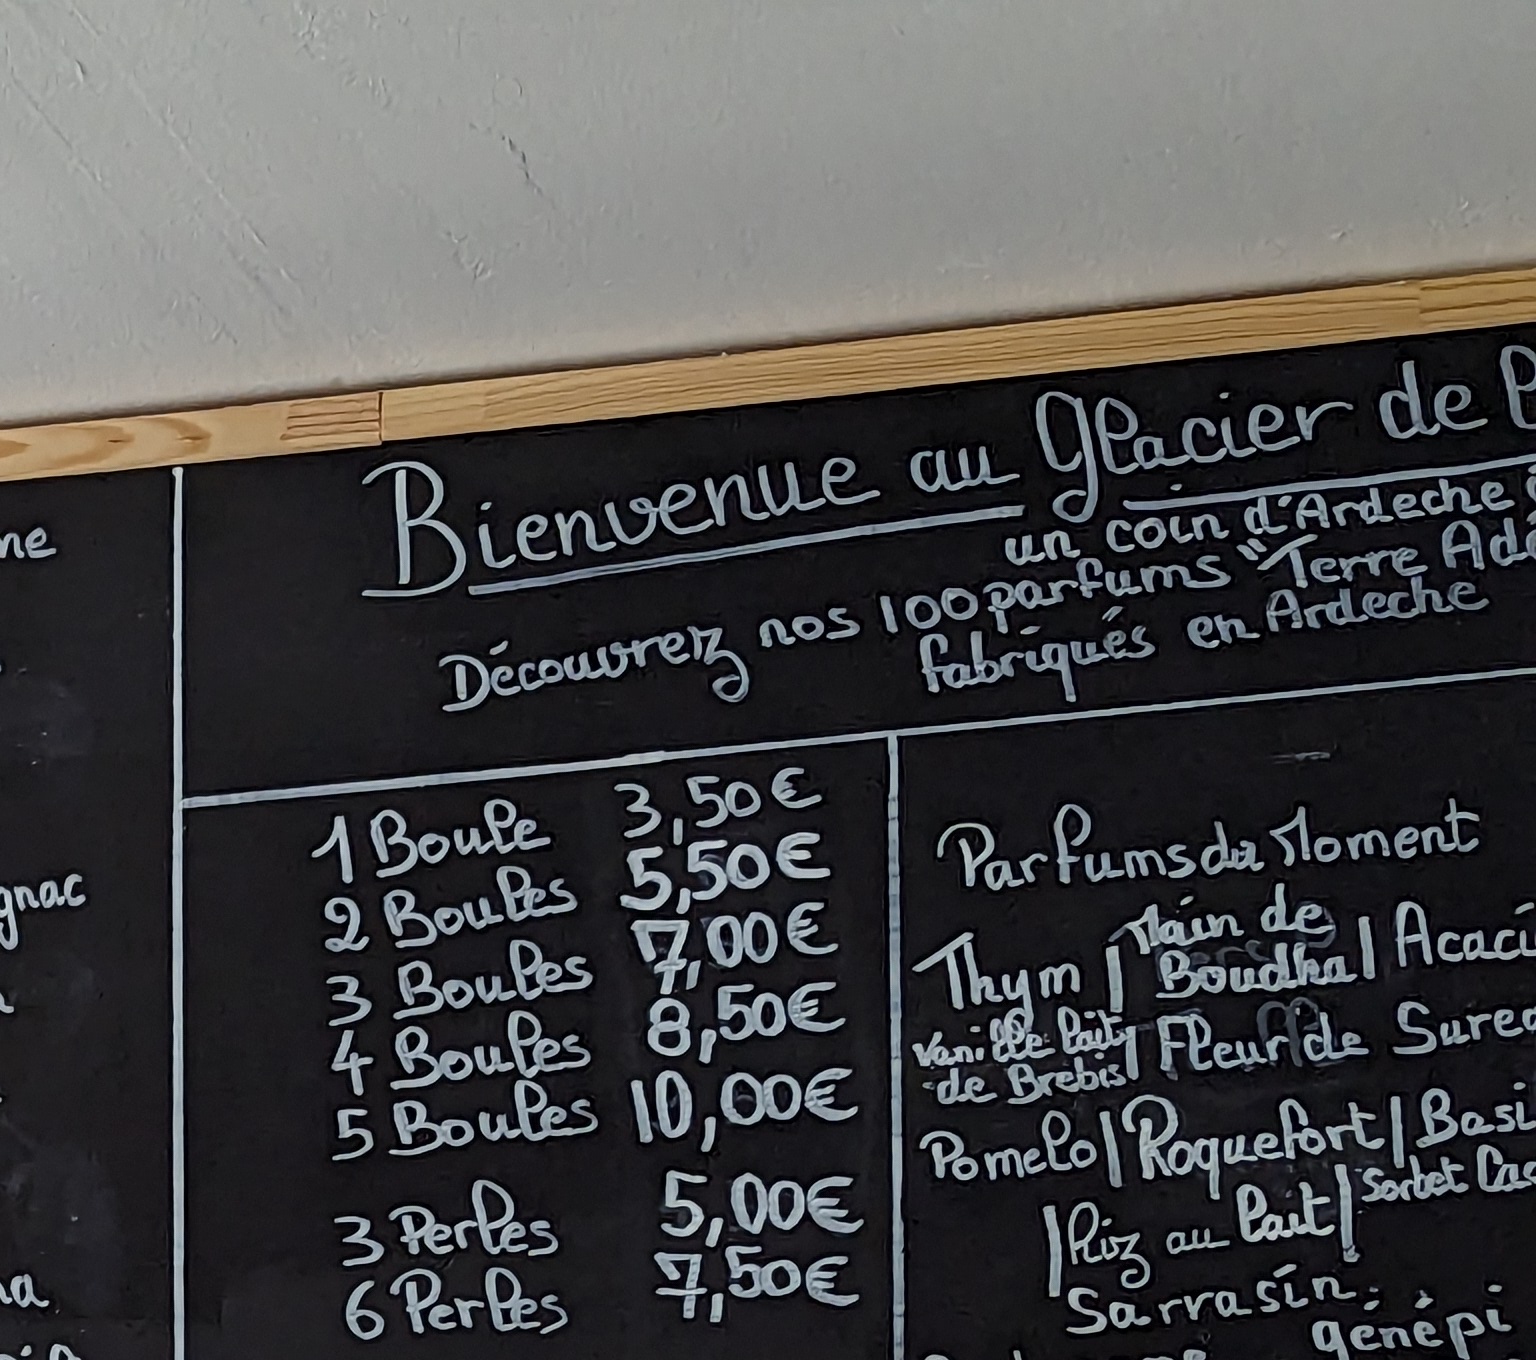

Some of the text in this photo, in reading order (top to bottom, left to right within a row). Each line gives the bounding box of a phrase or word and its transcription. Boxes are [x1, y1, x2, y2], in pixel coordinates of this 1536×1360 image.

[362, 361, 1487, 597] Bienvenue au de
[1005, 484, 1228, 565] un coin
[439, 606, 860, 712] Découvrez nos
[919, 581, 1489, 703] fabriqués en Ardeche
[311, 767, 822, 884] 1 Boule 3,50€
[1270, 798, 1480, 867] Moment
[325, 832, 831, 953] 2 Boules 5,50€
[1260, 883, 1330, 933] de
[326, 901, 839, 1026] 3 Boules 7,00€
[330, 982, 847, 1096] 4 Boules 8,50€
[1007, 1058, 1126, 1104] Brebis
[332, 1068, 858, 1160] 5 Boules 10,00€
[333, 1171, 864, 1267] 3 Perles 5,00€
[1165, 1227, 1230, 1255] au
[346, 1245, 860, 1340] 6 Perles 7,50€
[1066, 1265, 1357, 1334] Sarrasin
